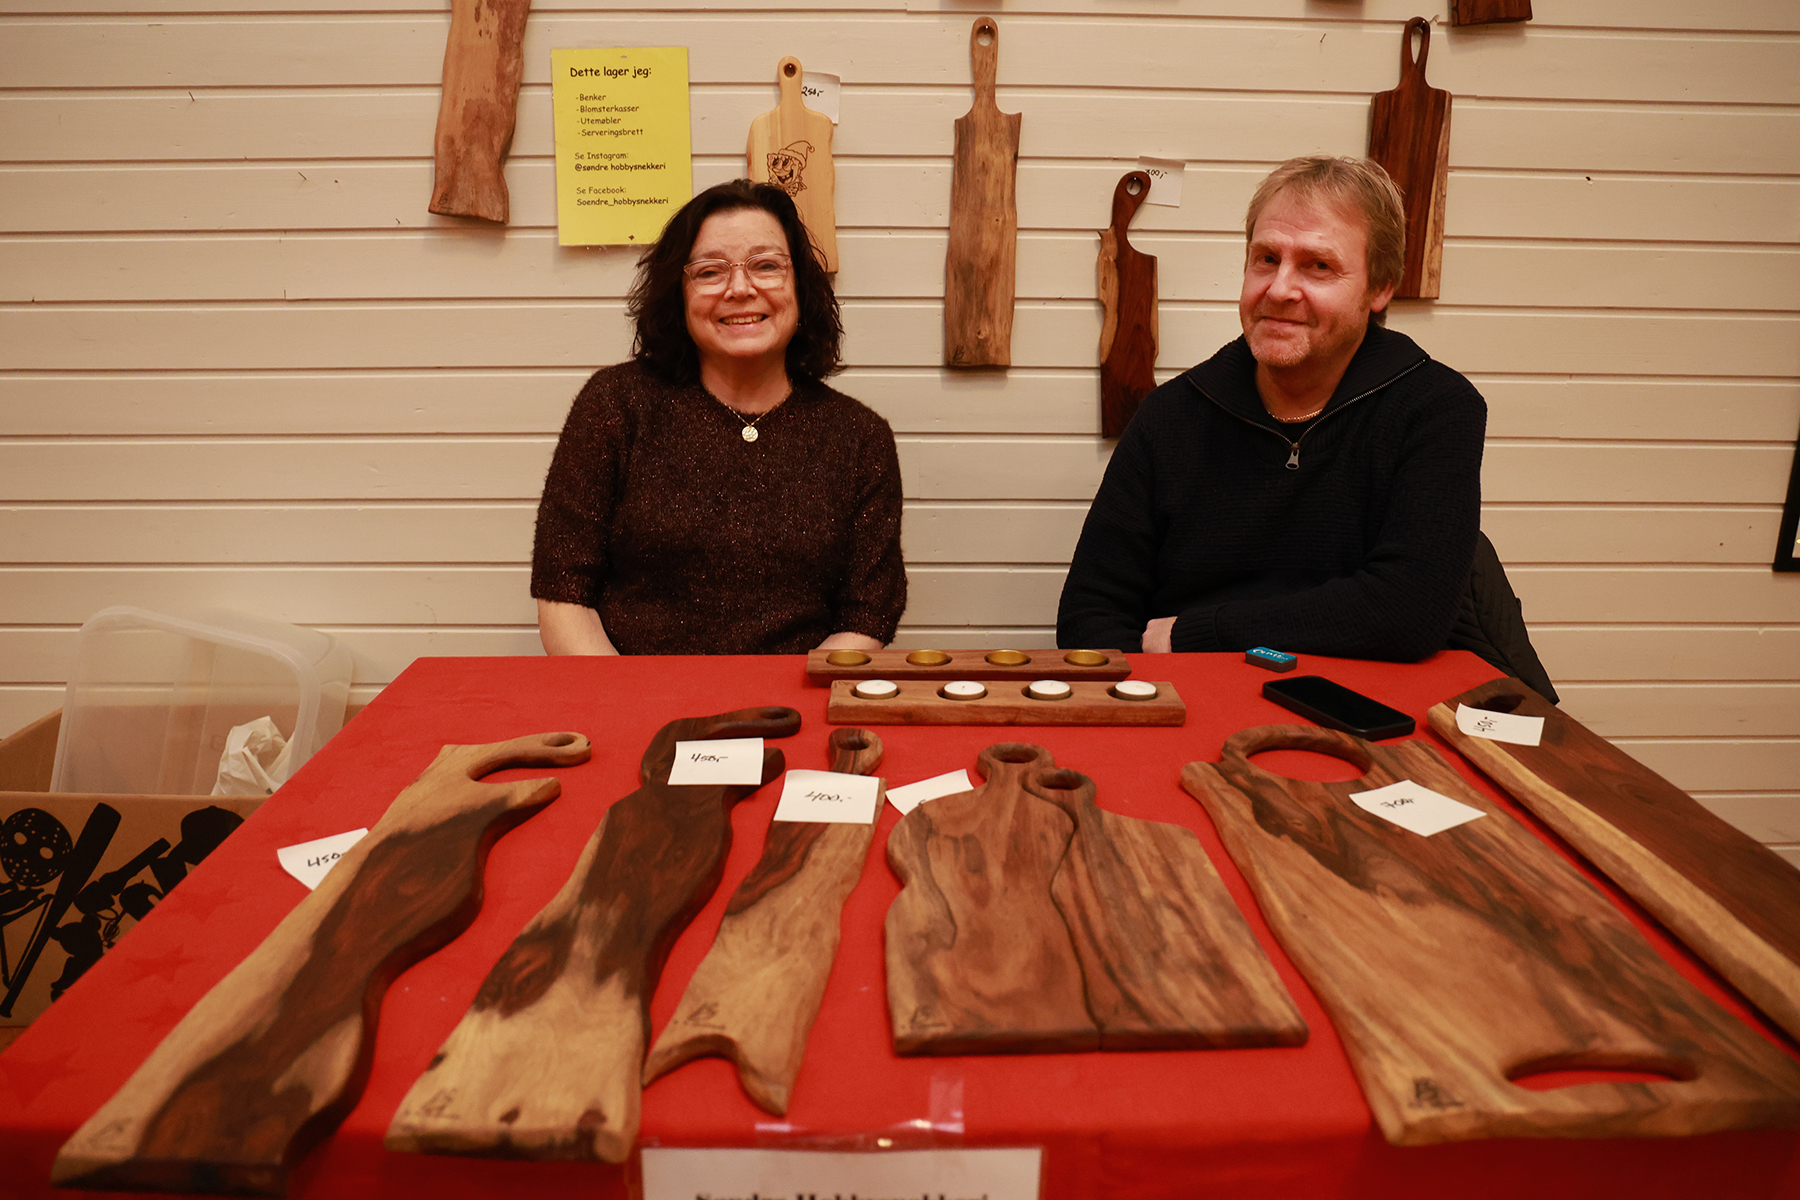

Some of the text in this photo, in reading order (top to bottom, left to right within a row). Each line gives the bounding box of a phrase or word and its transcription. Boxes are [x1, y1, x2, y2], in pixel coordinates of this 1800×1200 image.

[570, 66, 652, 79] Dette lager jeg:
[574, 152, 629, 161] Se Instagram:
[574, 162, 666, 172] @søndre hobbysnekkeri
[588, 186, 627, 194] Facebook:
[576, 197, 669, 206] Soendre_hobbysnekkeri
